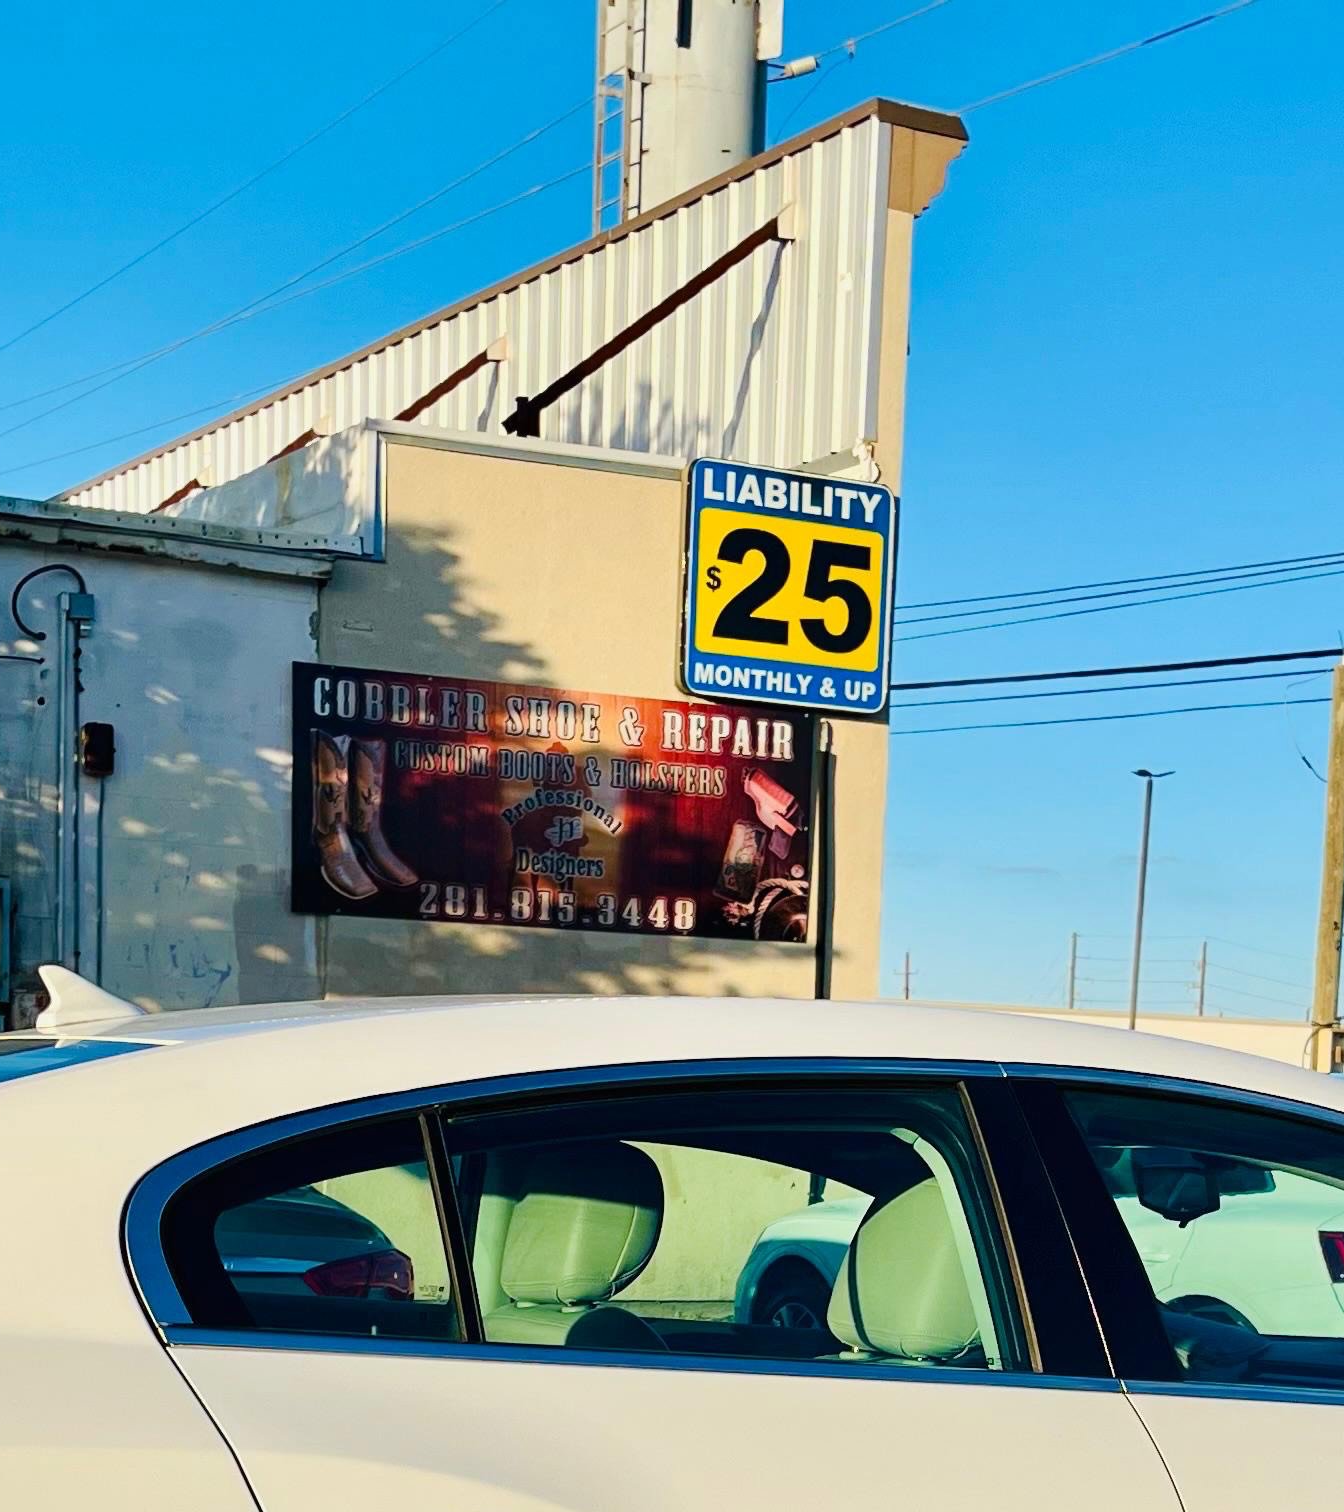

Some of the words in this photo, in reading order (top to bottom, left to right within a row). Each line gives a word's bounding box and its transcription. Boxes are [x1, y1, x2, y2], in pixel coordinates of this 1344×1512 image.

[703, 467, 883, 524] LIABILITY
[705, 527, 873, 655] $25
[693, 662, 814, 696] MONTHLY
[819, 677, 837, 699] &
[844, 679, 878, 702] UP
[313, 677, 488, 733] COBBLER
[505, 695, 601, 744] SHOE
[618, 706, 645, 747] &
[661, 710, 796, 762] REPAIR
[394, 739, 489, 777] CUSTOM
[499, 749, 575, 785] BOOTS
[585, 757, 602, 786] &
[611, 759, 727, 798] HOLSTERS
[500, 788, 623, 835] Professional
[516, 848, 605, 881] Designers
[419, 883, 697, 931] 281.815.3448
